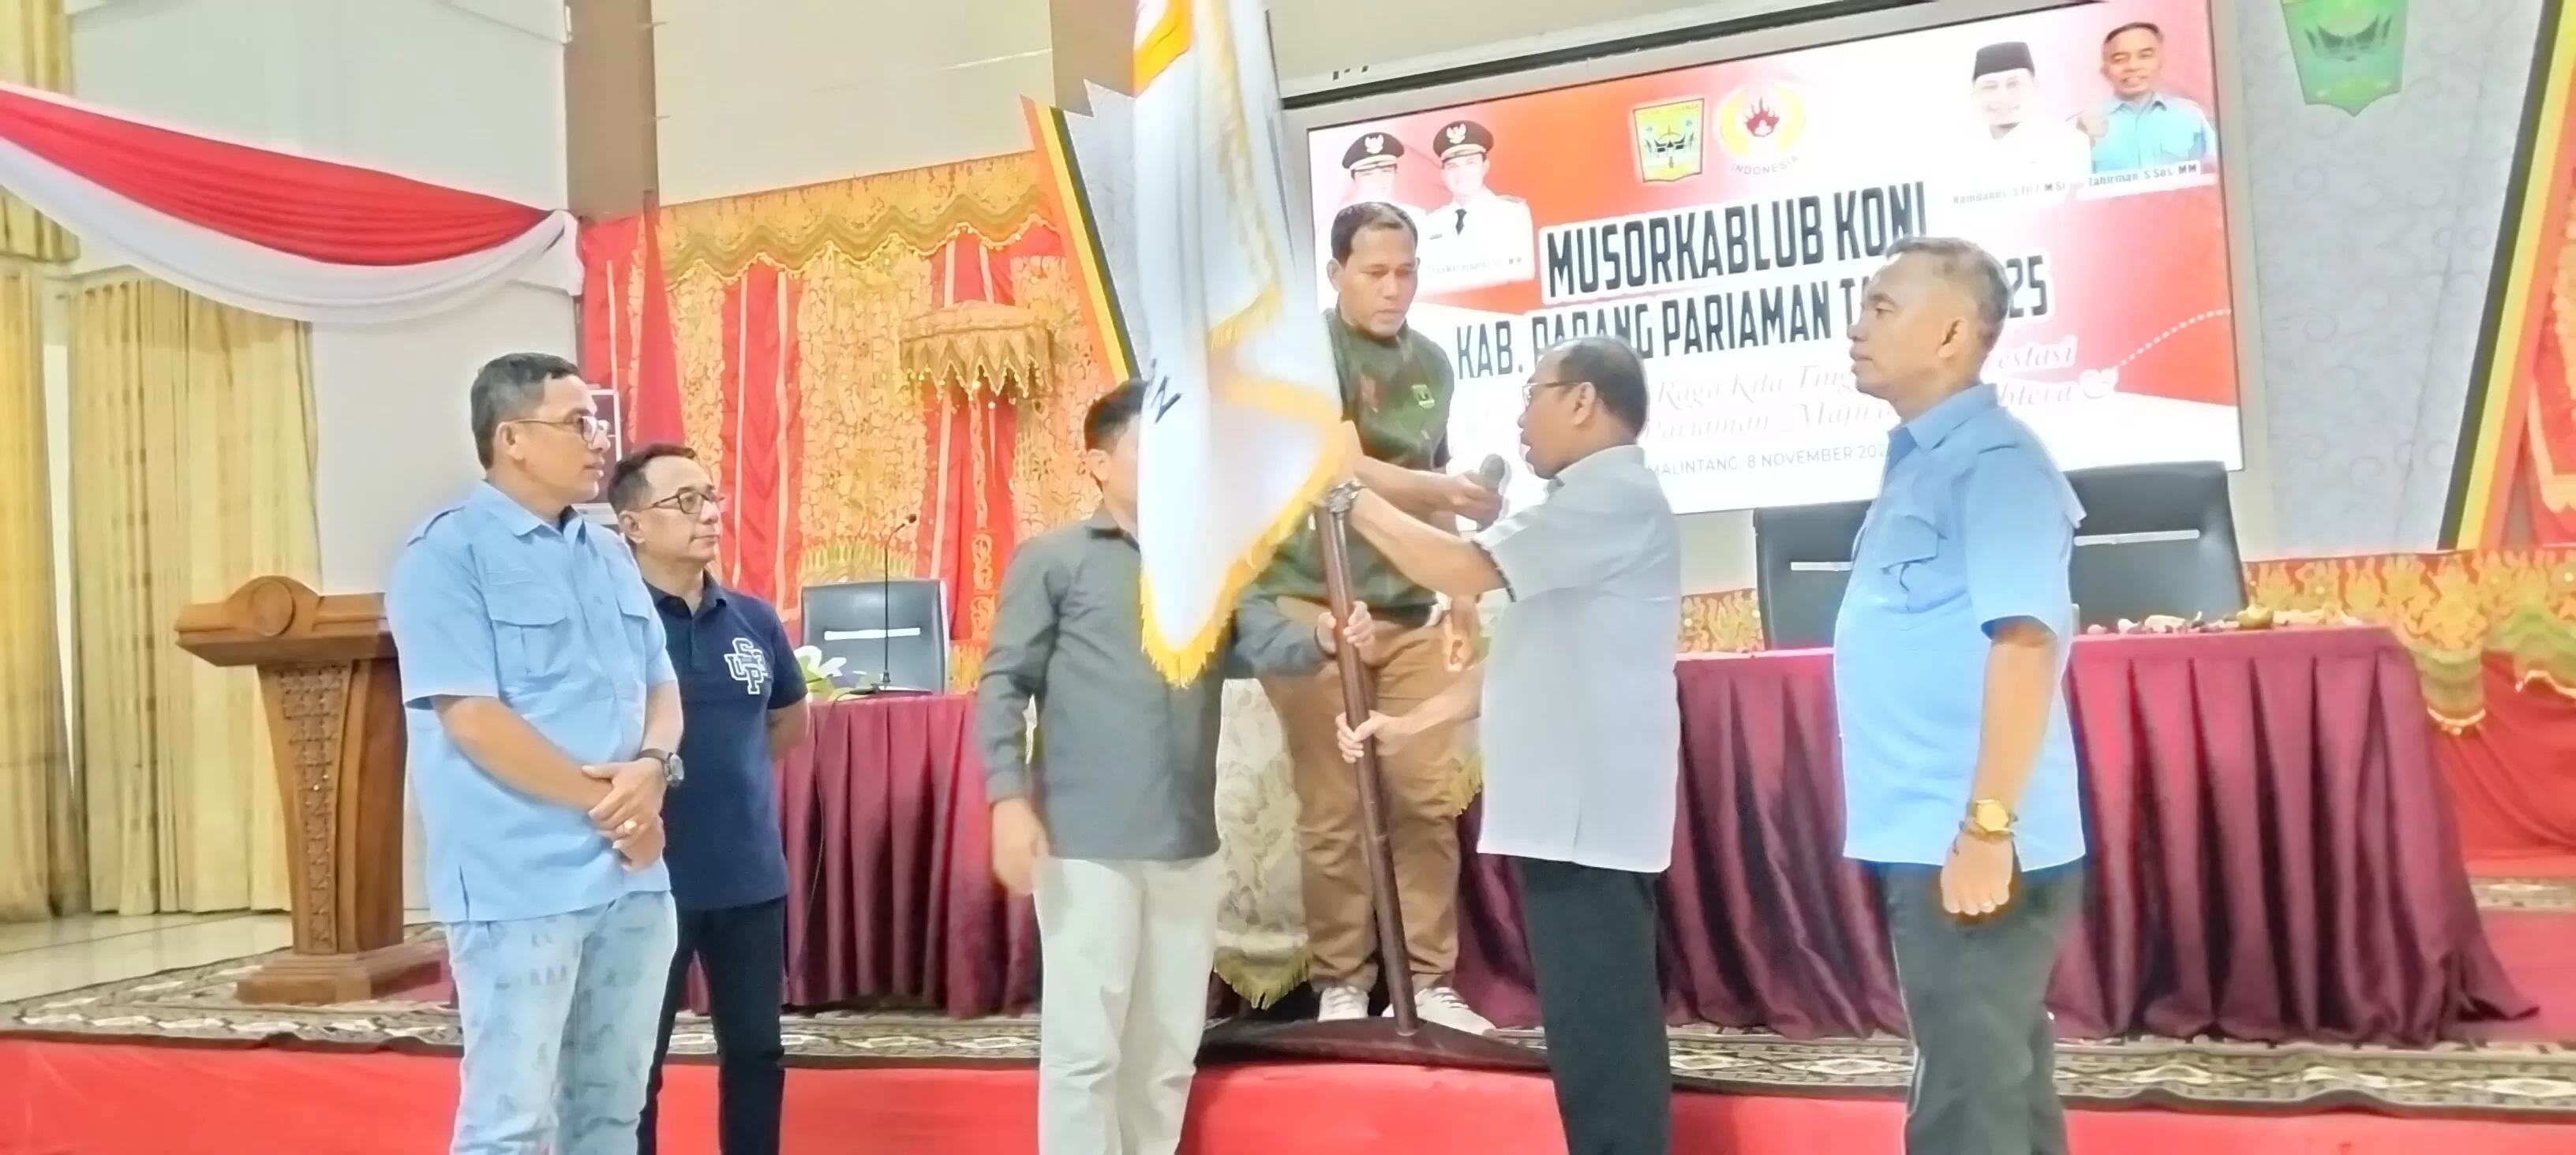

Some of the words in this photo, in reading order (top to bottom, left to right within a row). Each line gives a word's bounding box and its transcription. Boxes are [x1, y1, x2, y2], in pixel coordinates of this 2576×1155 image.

[1731, 155, 1800, 175] INDONESIA
[2088, 174, 2139, 186] Zahirman
[1546, 195, 1825, 298] MUSORKABLUB
[1833, 181, 1927, 261] KONI
[1456, 320, 1524, 380] KAB.
[1661, 280, 1833, 357] PARIAMAN
[1747, 454, 1757, 469] 8
[1762, 446, 1853, 468] NOVEMBER
